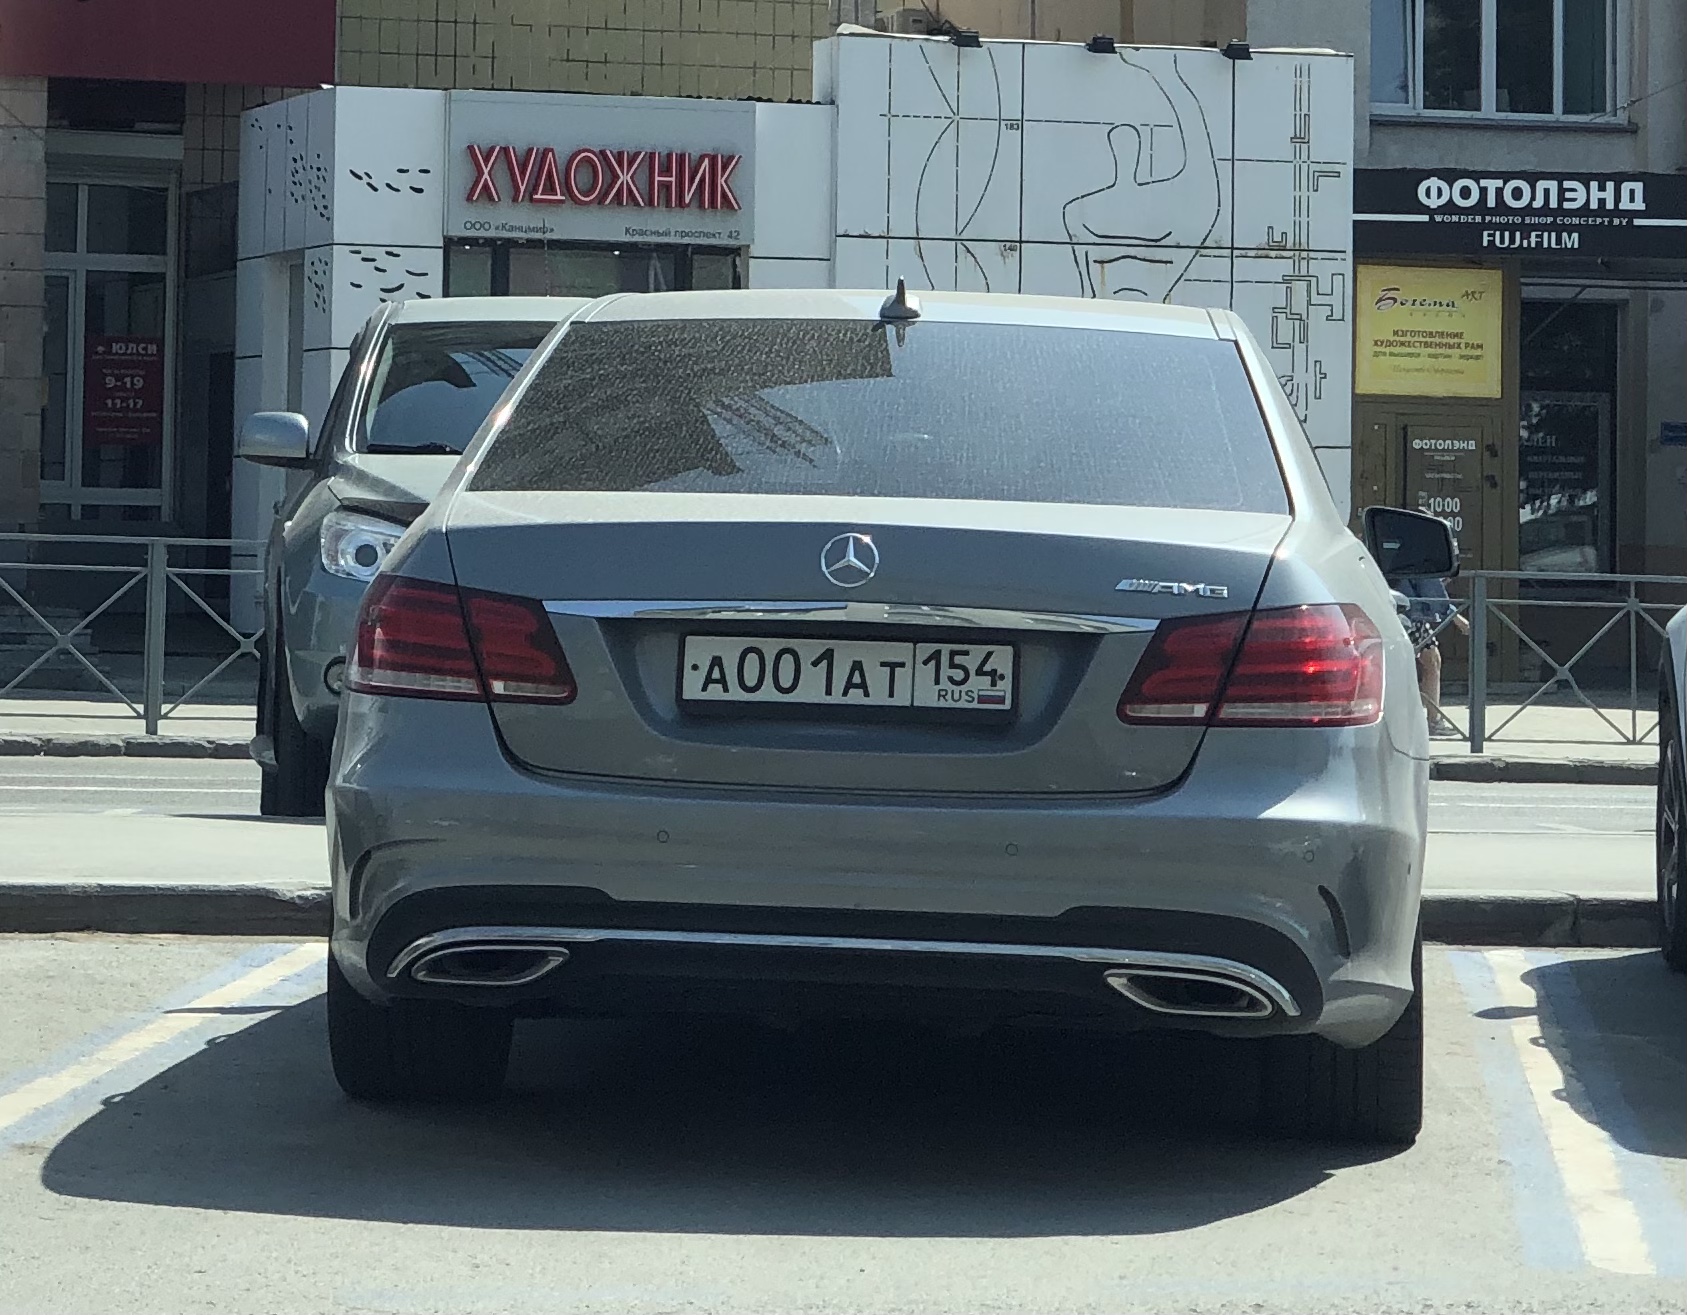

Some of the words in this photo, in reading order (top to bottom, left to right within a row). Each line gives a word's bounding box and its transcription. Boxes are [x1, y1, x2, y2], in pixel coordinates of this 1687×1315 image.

[1005, 123, 1020, 131] 183
[466, 144, 742, 210] ХУДОЖНИК
[1417, 176, 1646, 211] ФОТОЛЭНД
[463, 220, 492, 232] ООО
[1433, 214, 1482, 224] WONDER
[1484, 215, 1522, 225] PHOTO
[1524, 215, 1554, 225] SHOP
[1556, 216, 1610, 226] CONCEPT
[1612, 217, 1629, 226] BY
[624, 226, 671, 238] Красный
[674, 229, 722, 240] проспект
[727, 230, 741, 240] 42
[1461, 289, 1485, 302] ART
[1392, 329, 1465, 340] ИЗГОТОВЛЕНИЕ
[111, 342, 157, 355] ЮЛСИ
[1373, 339, 1462, 351] ХУДОЖЕСТВЕННЫХ
[1464, 341, 1484, 352] РАМ
[105, 376, 145, 389] 9-19
[105, 398, 144, 409] 11-17
[1412, 438, 1476, 450] ФОТОЛЭНД
[1151, 581, 1229, 599] AMG
[921, 648, 999, 688] 154
[937, 688, 976, 704] RUS
